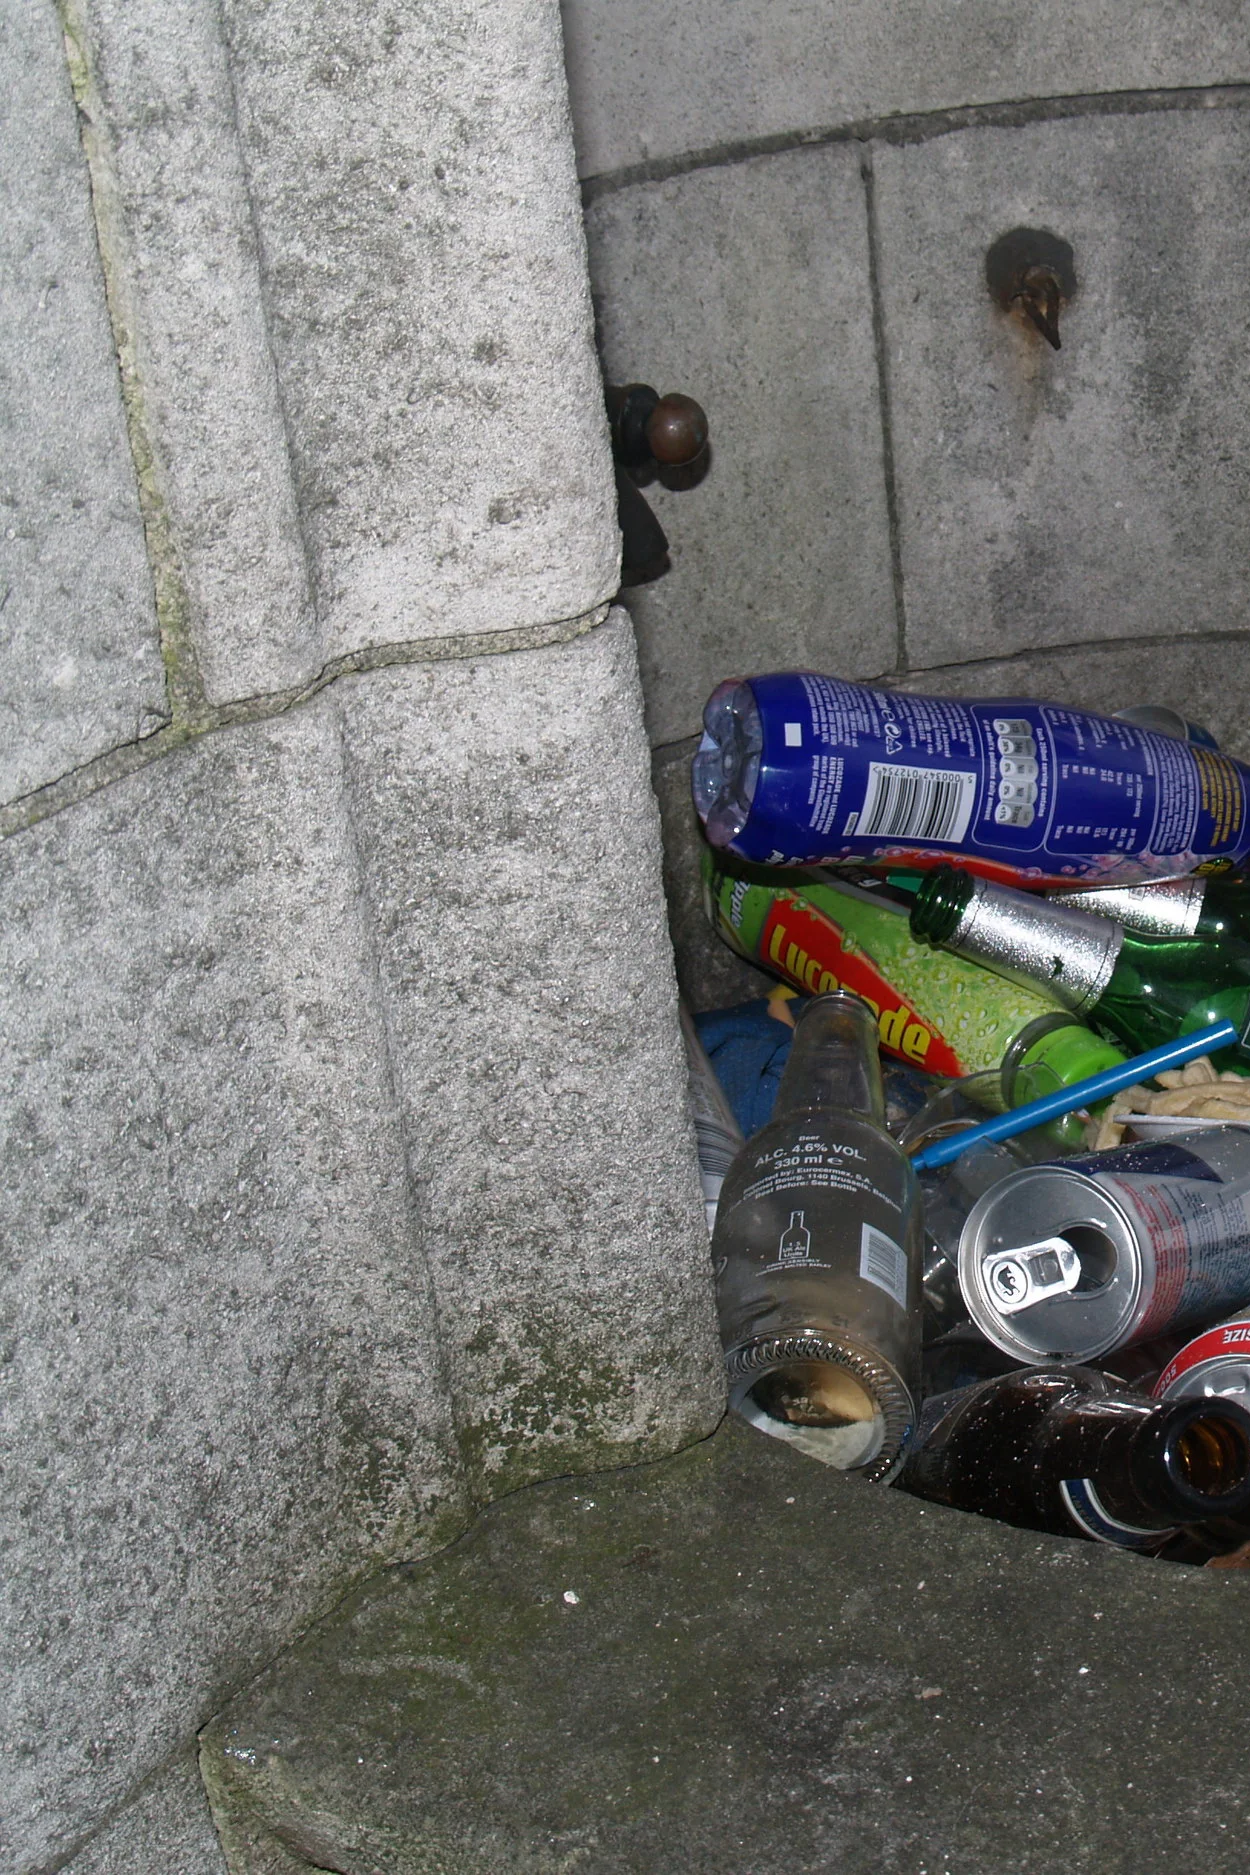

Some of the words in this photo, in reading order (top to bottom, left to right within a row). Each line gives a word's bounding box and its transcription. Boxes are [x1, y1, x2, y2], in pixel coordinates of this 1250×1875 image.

[881, 765, 918, 779] 012754
[922, 770, 960, 783] 000347
[768, 923, 932, 1065] Lucode
[754, 1148, 788, 1169] ALC.
[791, 1142, 828, 1154] 4.6%
[832, 1144, 867, 1162] VOL.
[773, 1156, 801, 1170] 330
[804, 1154, 823, 1164] ml
[810, 1179, 829, 1187] See
[830, 1181, 857, 1193] Bottle
[855, 1173, 873, 1185] S.A.
